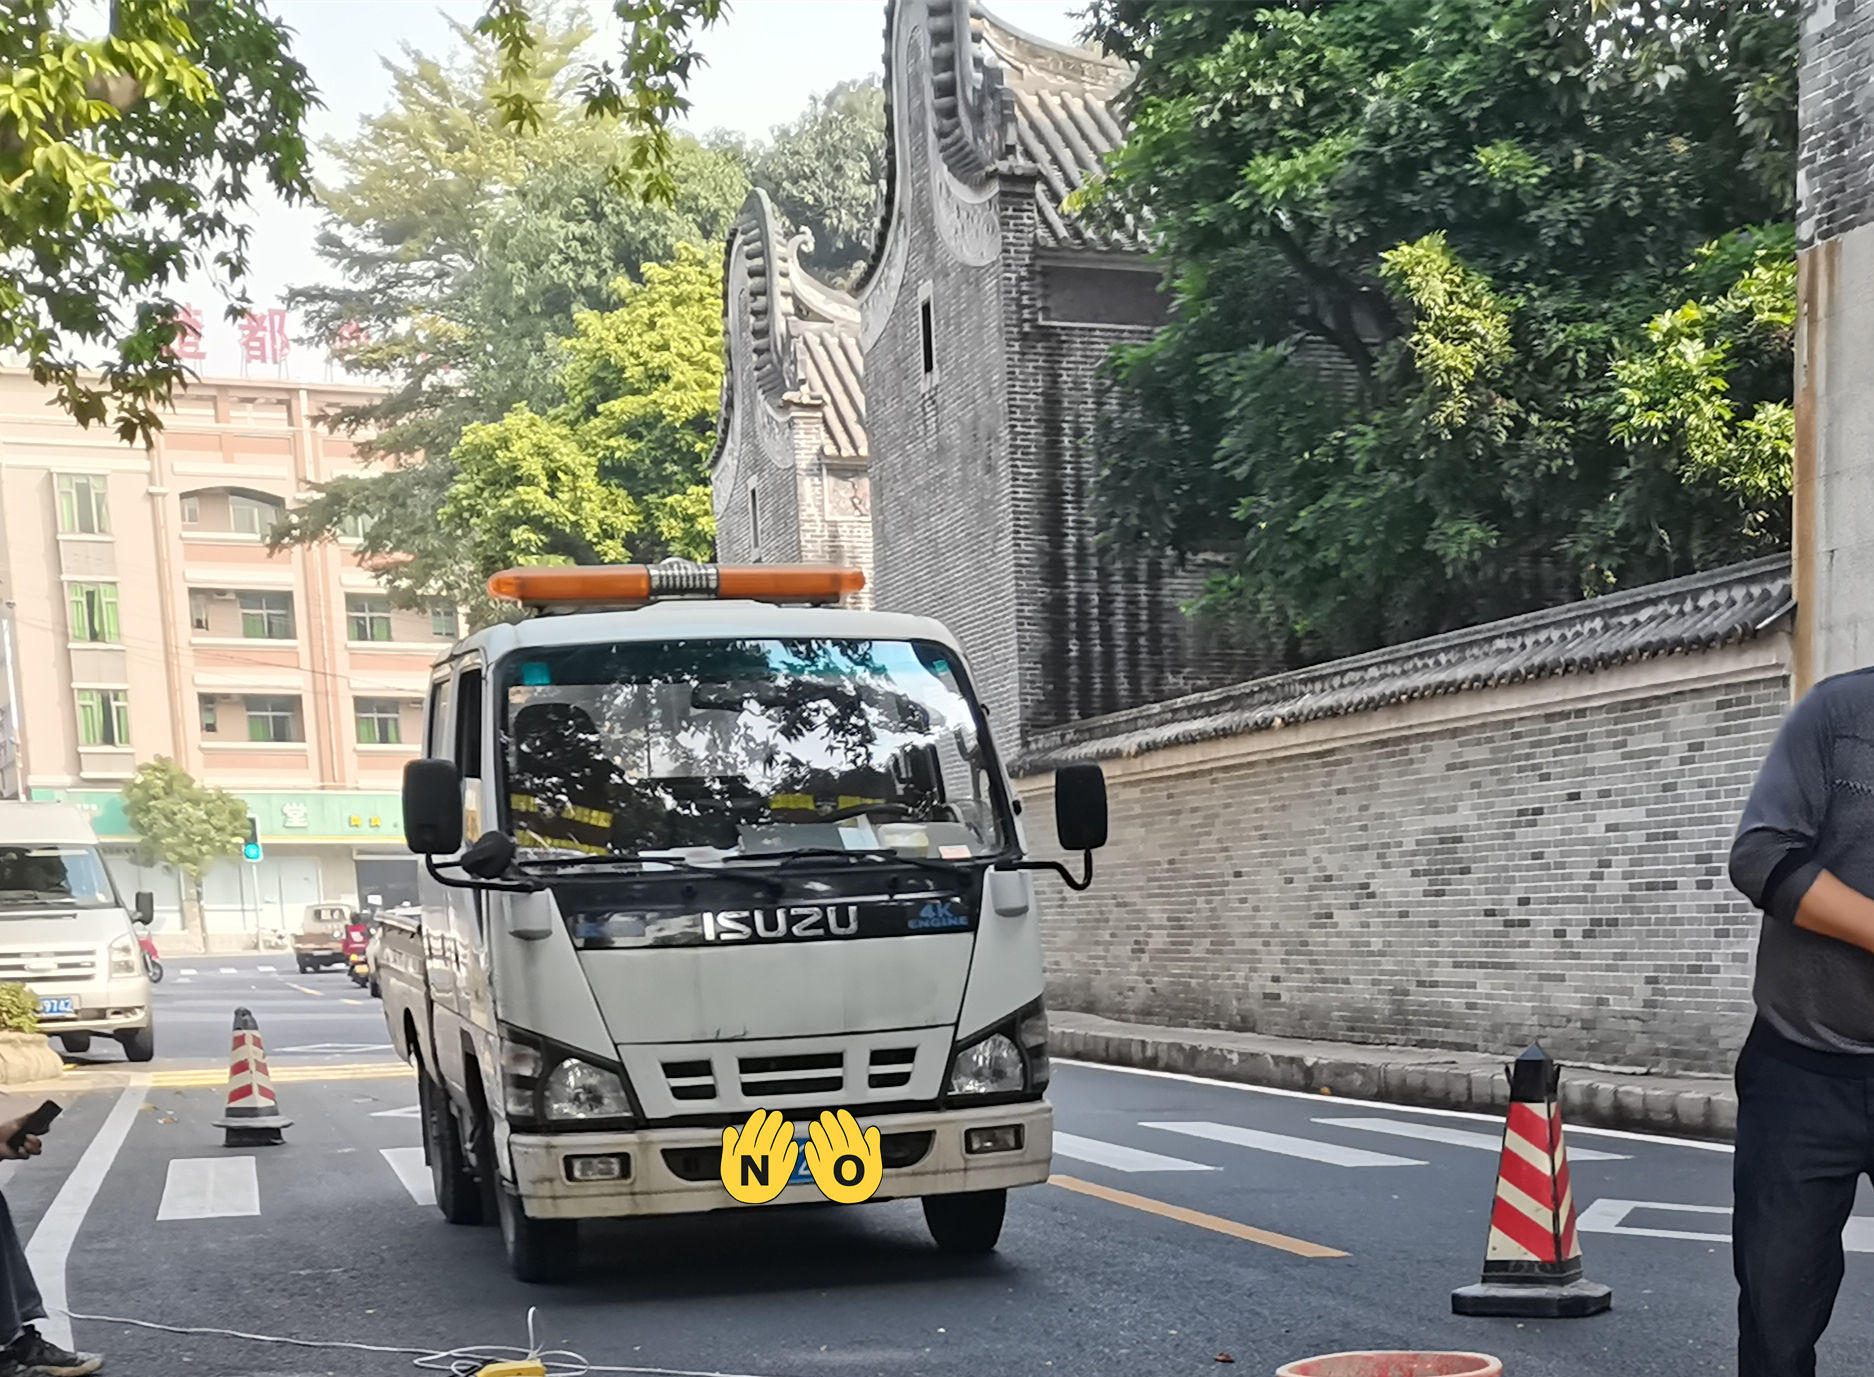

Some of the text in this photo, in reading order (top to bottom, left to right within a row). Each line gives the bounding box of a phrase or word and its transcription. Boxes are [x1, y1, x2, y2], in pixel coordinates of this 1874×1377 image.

[919, 902, 953, 918] 4K
[702, 905, 859, 941] ISUZU
[907, 915, 969, 930] ENGINE
